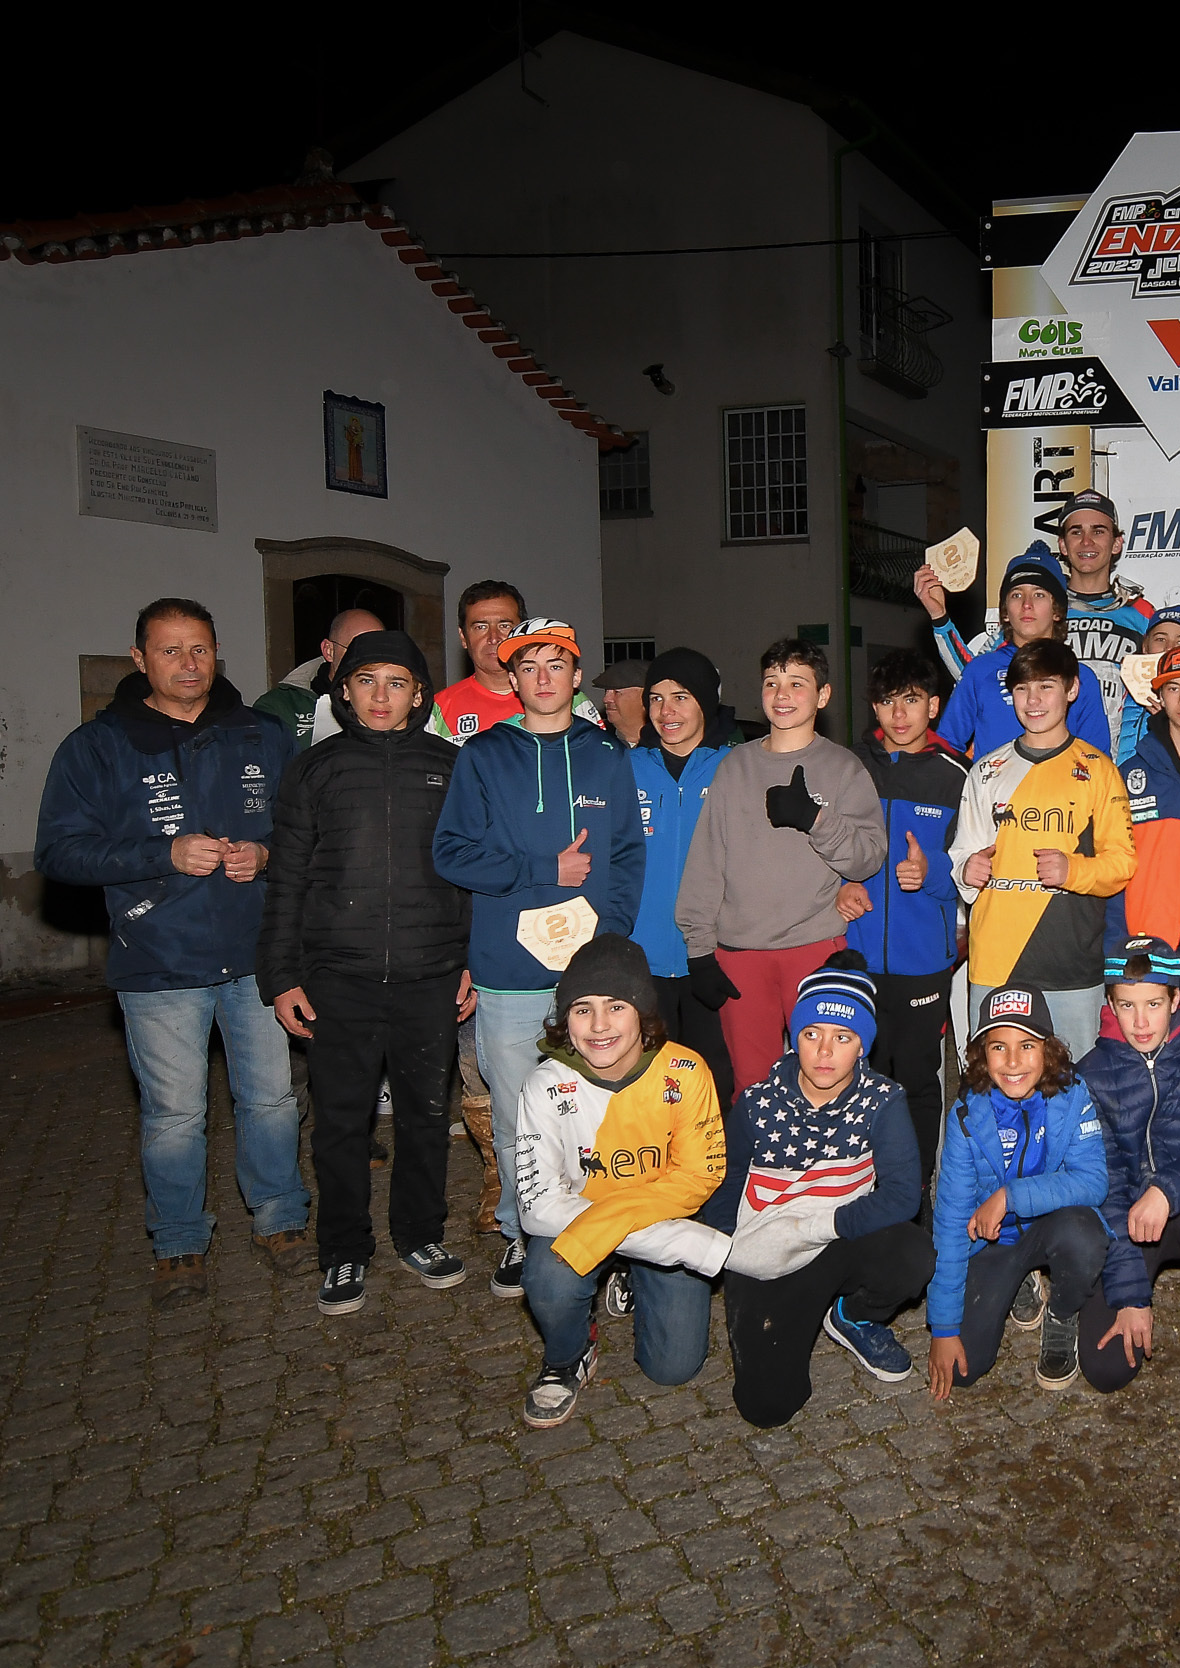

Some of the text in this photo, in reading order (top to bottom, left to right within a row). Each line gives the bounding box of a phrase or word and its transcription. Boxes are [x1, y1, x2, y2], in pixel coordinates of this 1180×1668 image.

[1112, 204, 1146, 221] FMP
[1086, 259, 1142, 274] 2023
[1141, 280, 1178, 289] GASGAS
[1004, 372, 1074, 412] FMP
[944, 545, 961, 567] 2
[1066, 632, 1138, 662] AMP
[1141, 661, 1156, 680] 3
[158, 772, 176, 784] CA
[1021, 802, 1075, 834] eni
[546, 914, 569, 940] 2
[994, 992, 1030, 1005] LIQUI
[818, 1010, 852, 1020] RACING
[825, 1002, 854, 1016] YAMAHA
[992, 1002, 1029, 1017] MOLY
